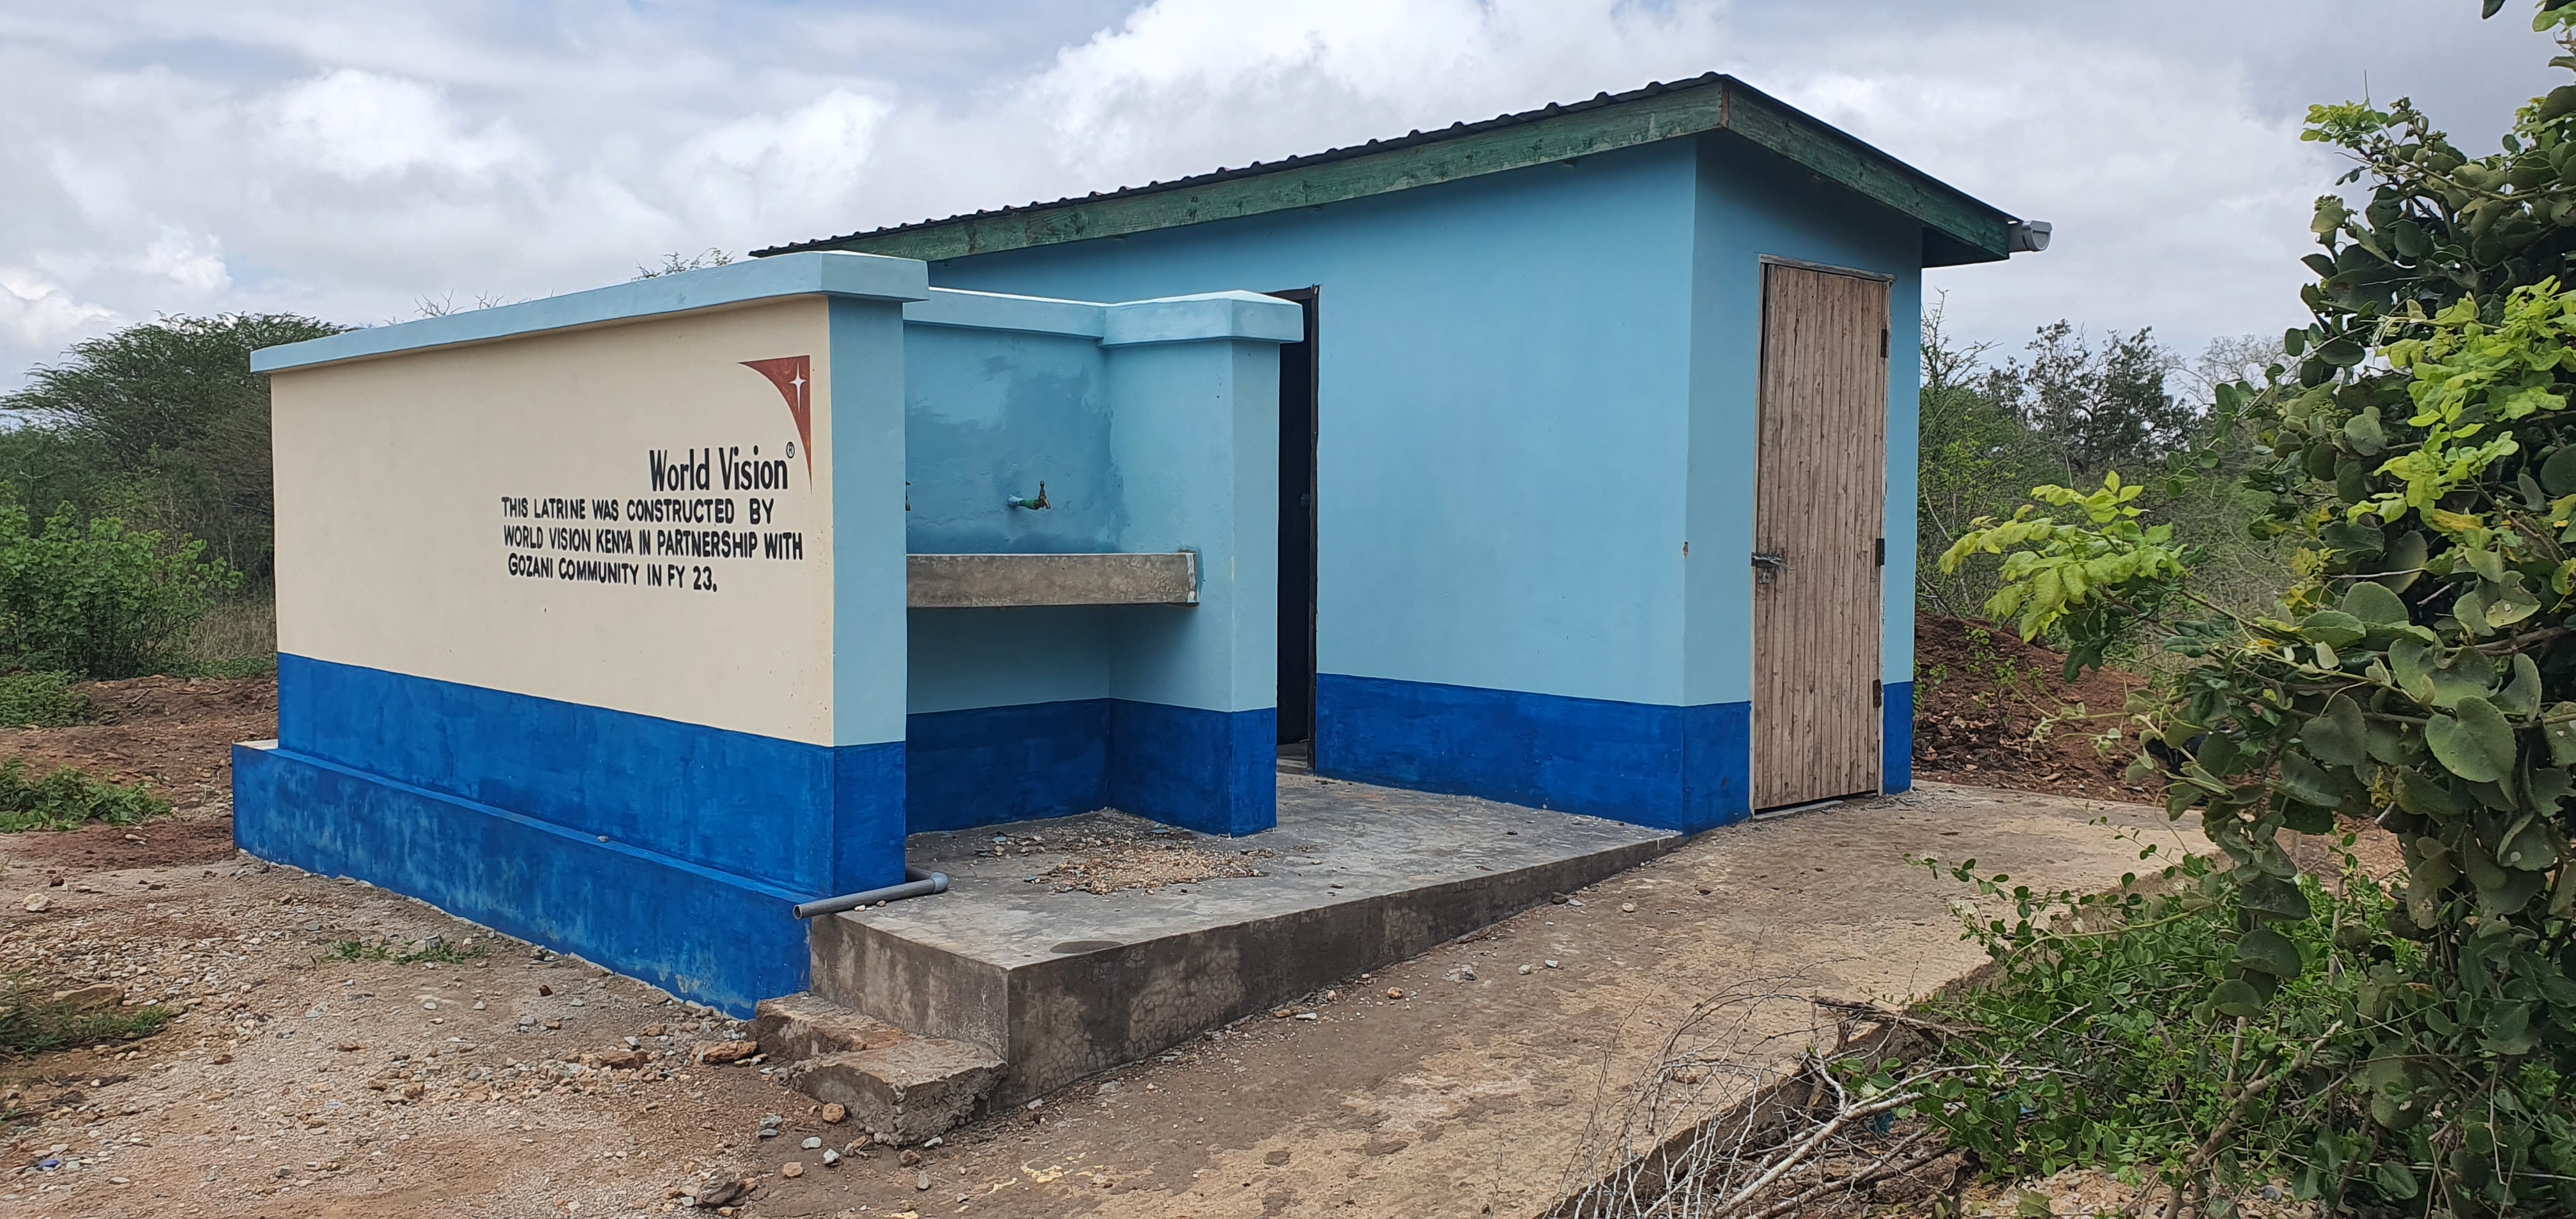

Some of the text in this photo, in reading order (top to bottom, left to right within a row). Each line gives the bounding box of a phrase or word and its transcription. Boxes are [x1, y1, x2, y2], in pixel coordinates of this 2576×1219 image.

[649, 447, 710, 491] World
[501, 496, 774, 525] THIS LATRINE WAS CONSTRUCTED BY
[503, 525, 803, 560] WORLD VISION KENYA IN PARTNERSHIP WITH
[508, 552, 717, 592] GOZANI COMMUNITY IN FY 23.
